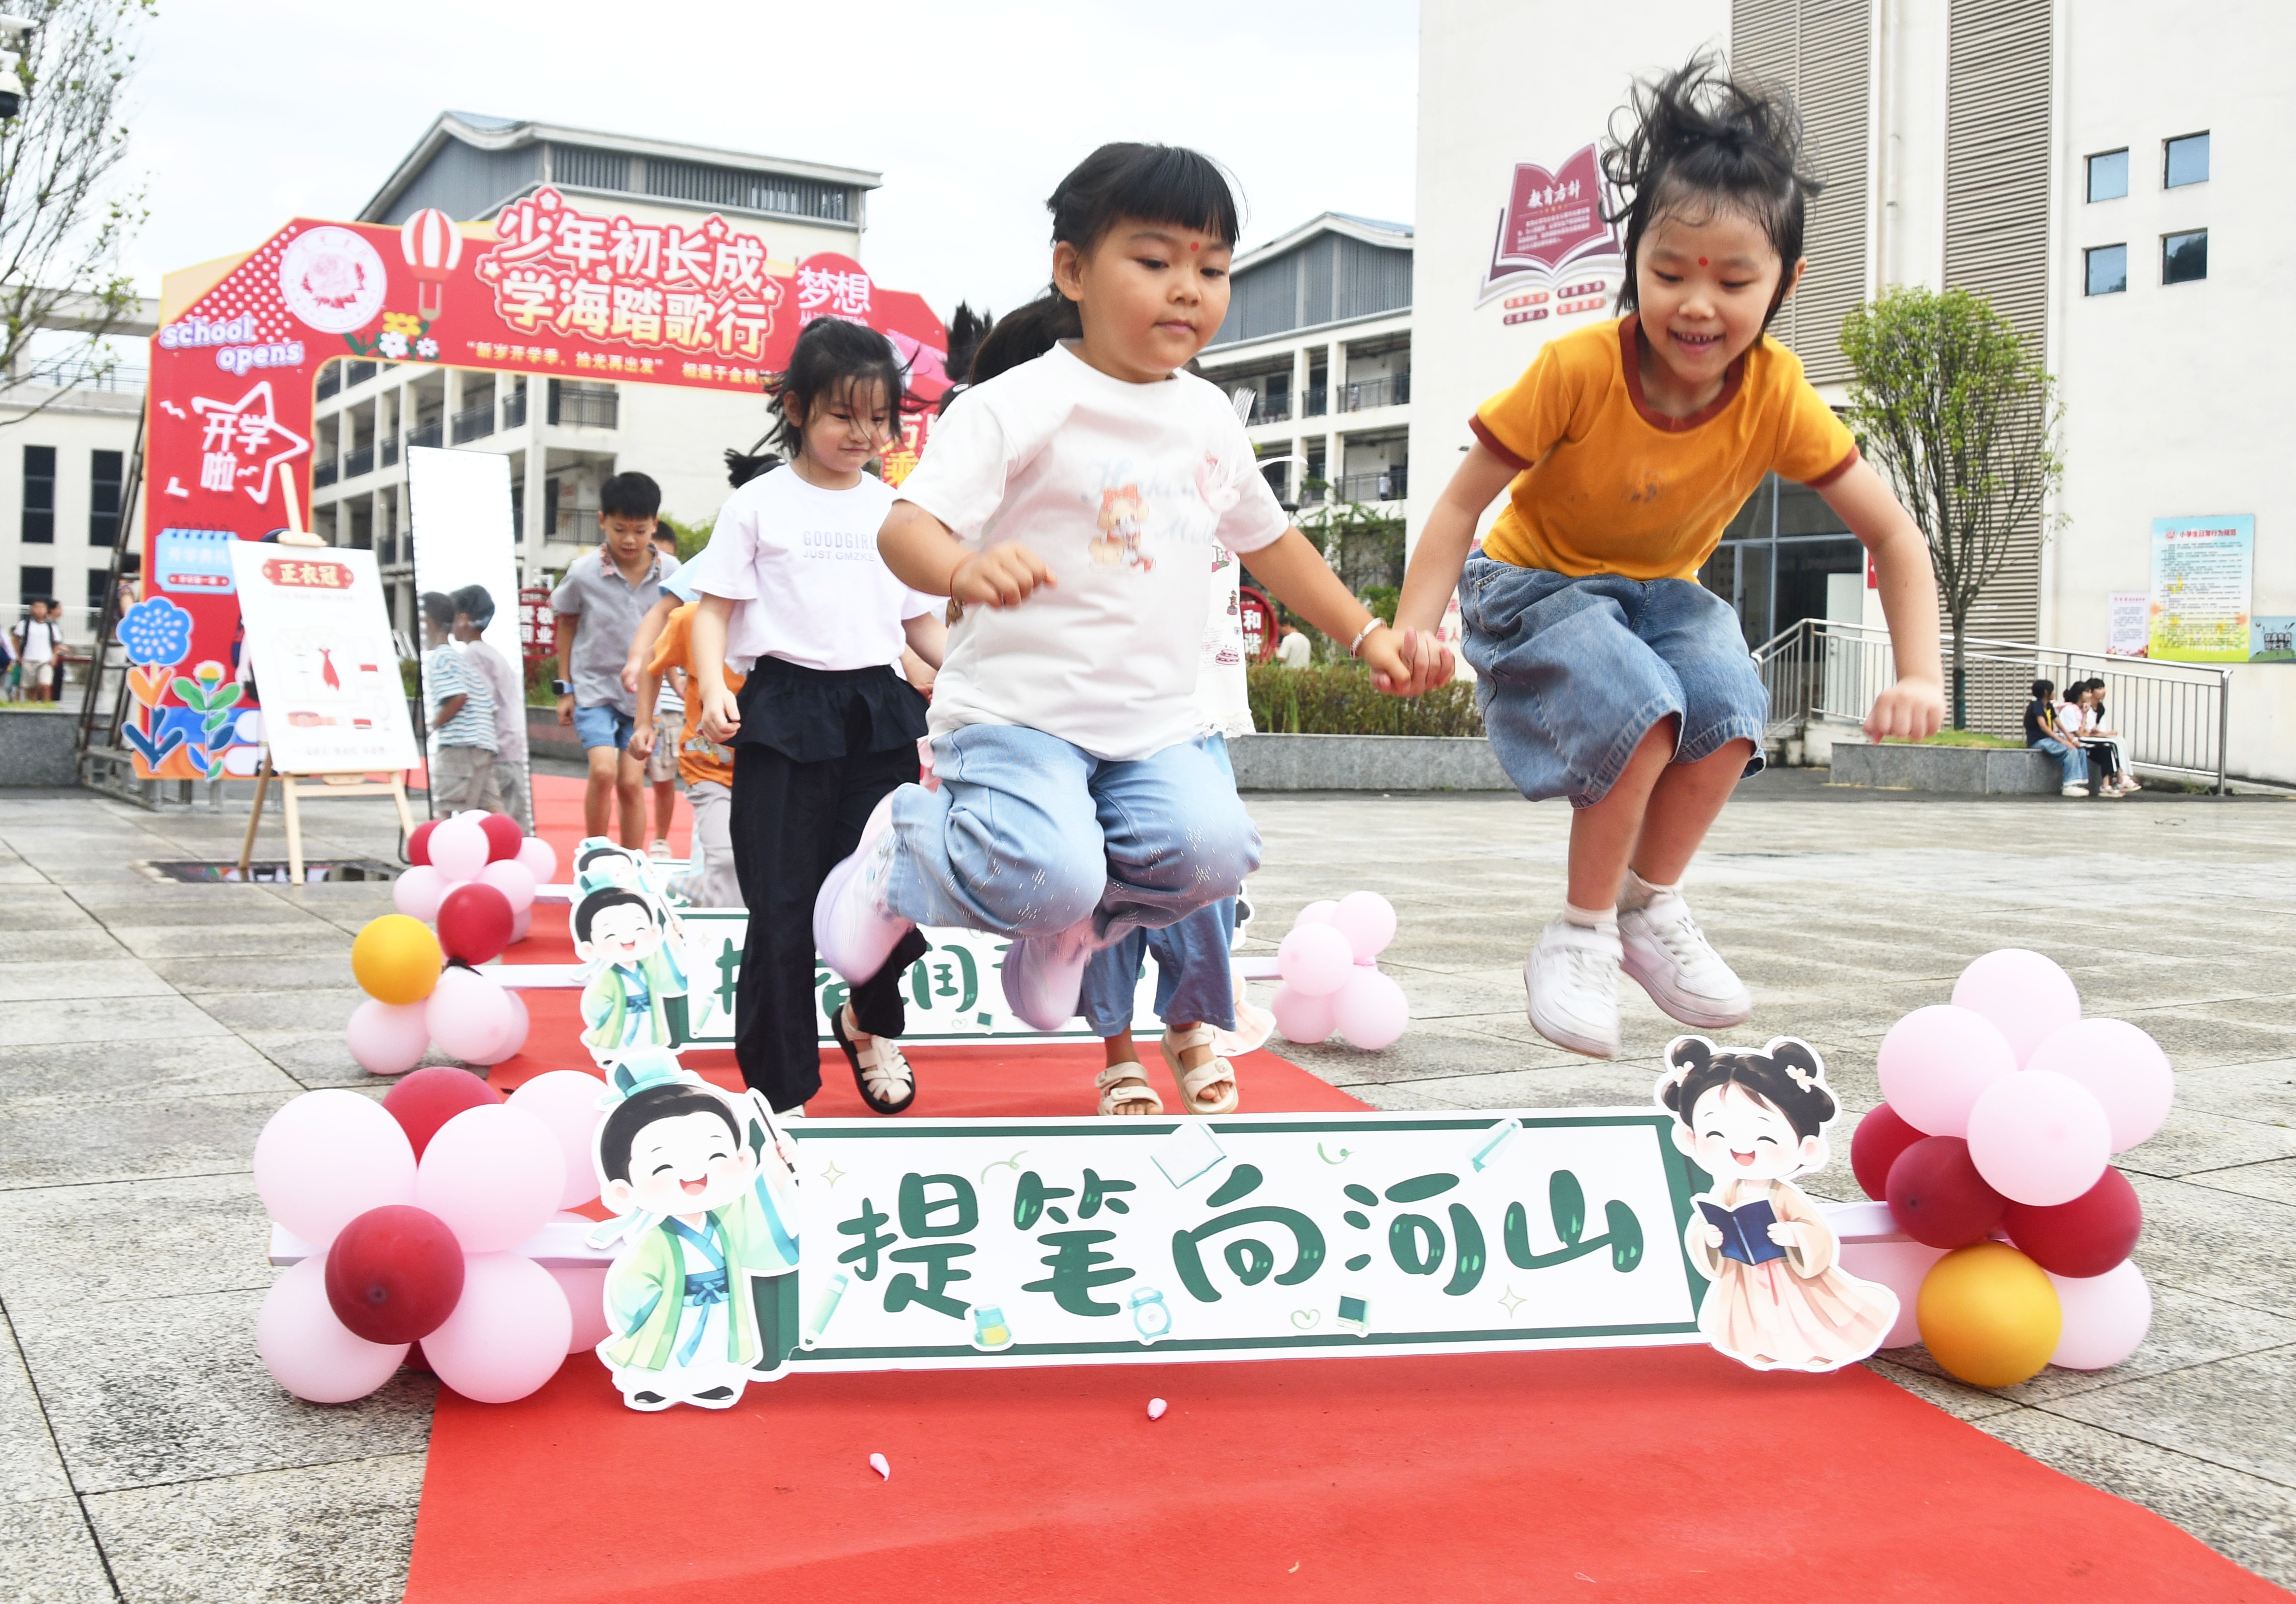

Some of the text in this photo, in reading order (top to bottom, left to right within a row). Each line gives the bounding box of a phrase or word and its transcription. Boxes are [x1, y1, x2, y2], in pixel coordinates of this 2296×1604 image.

[497, 205, 765, 293] 少年初长成
[796, 266, 872, 314] 梦想
[161, 313, 252, 346] school
[502, 270, 770, 355] 学海踏歌行
[218, 341, 302, 375] opens
[202, 412, 270, 454] 开学
[200, 451, 238, 492] 啦
[803, 530, 876, 550] GOODGIRL
[803, 550, 831, 559] JUST
[278, 563, 341, 587] 正衣冠
[836, 1163, 1644, 1321] 提笔向河山
